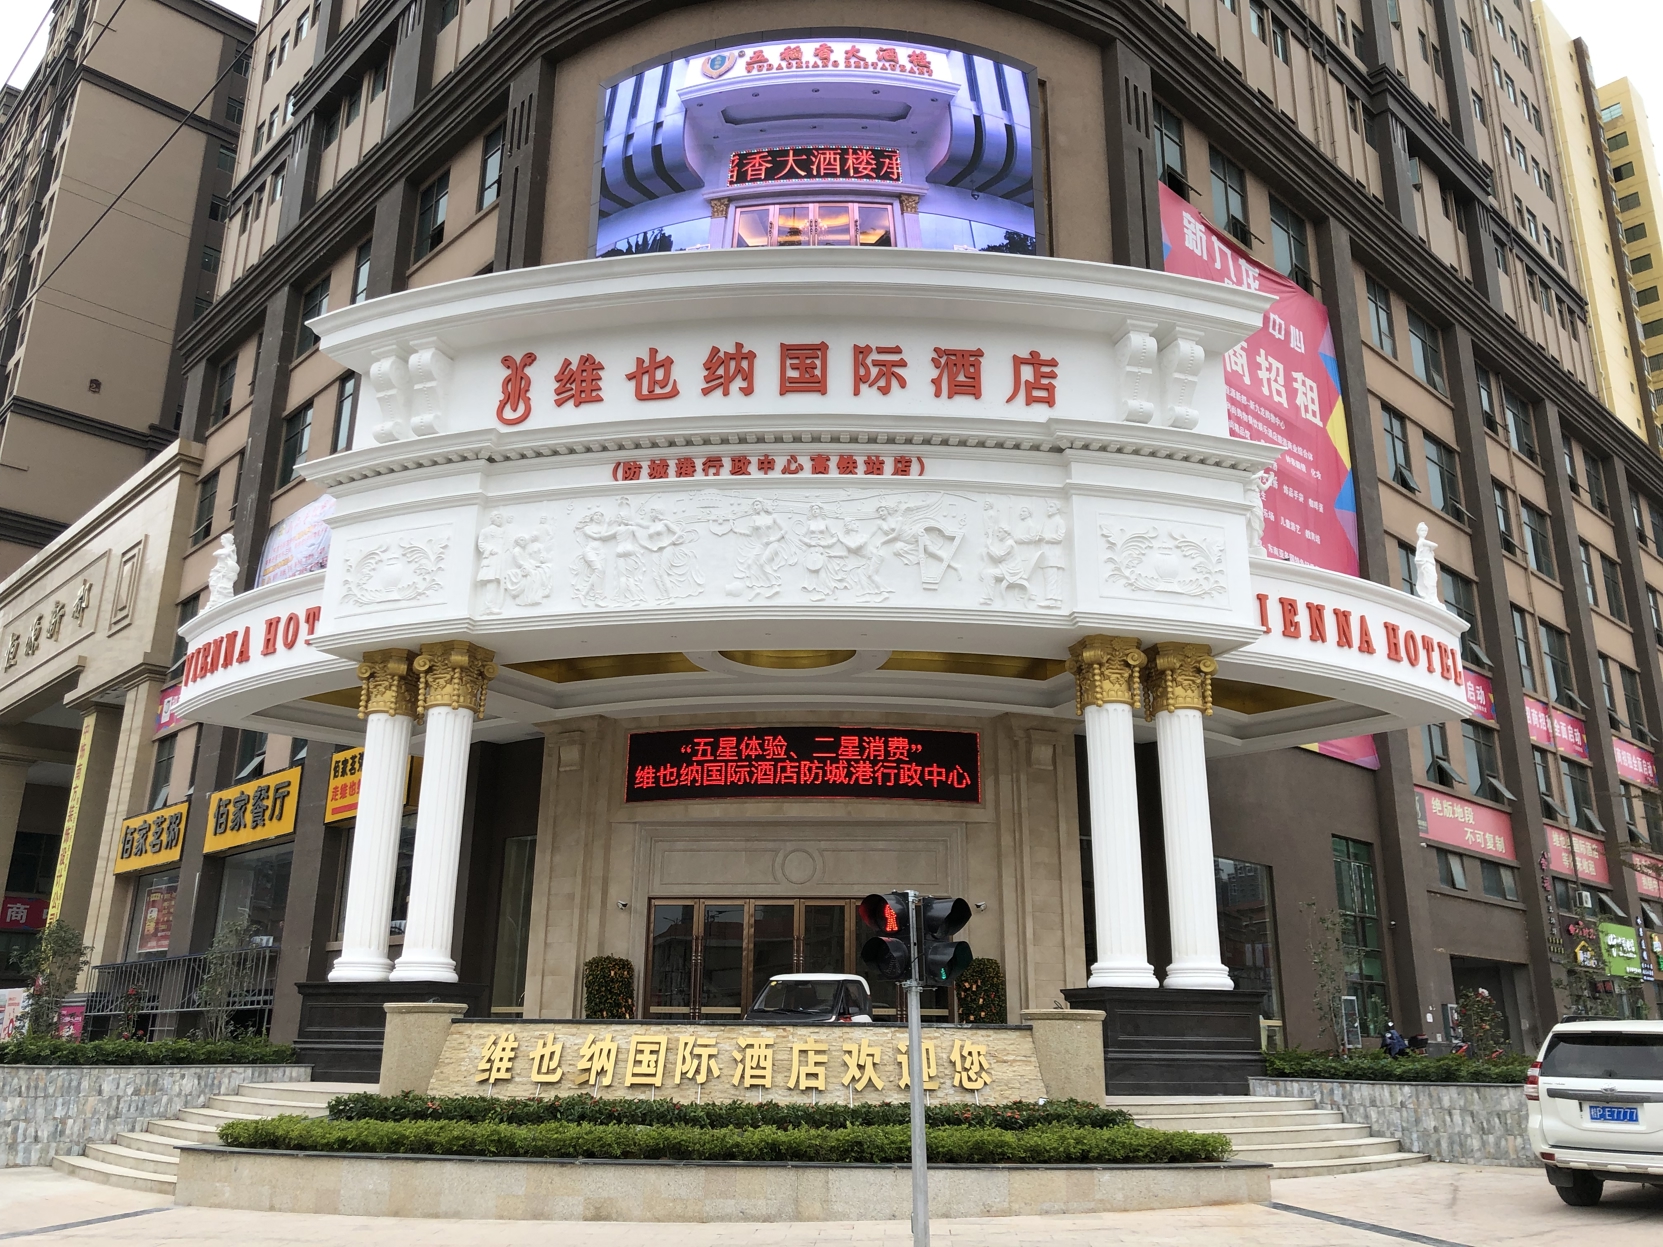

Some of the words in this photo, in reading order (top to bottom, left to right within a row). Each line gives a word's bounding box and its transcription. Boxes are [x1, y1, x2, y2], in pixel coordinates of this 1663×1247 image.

[553, 341, 1060, 408] 维也纳国际酒店
[612, 454, 925, 482] (防城港行政中心高铁站店)
[183, 626, 251, 687] VIENNA
[1383, 621, 1463, 686] HOTEL
[634, 760, 971, 789] 维也纳国际酒店防城港行政中心
[213, 780, 291, 836] 佰家餐厅
[1431, 797, 1475, 825] 绝版地段
[120, 812, 182, 860] 佰家茗粥
[1464, 827, 1506, 853] 不可复制
[474, 1032, 993, 1093] 维也纳国际酒店欢迎您
